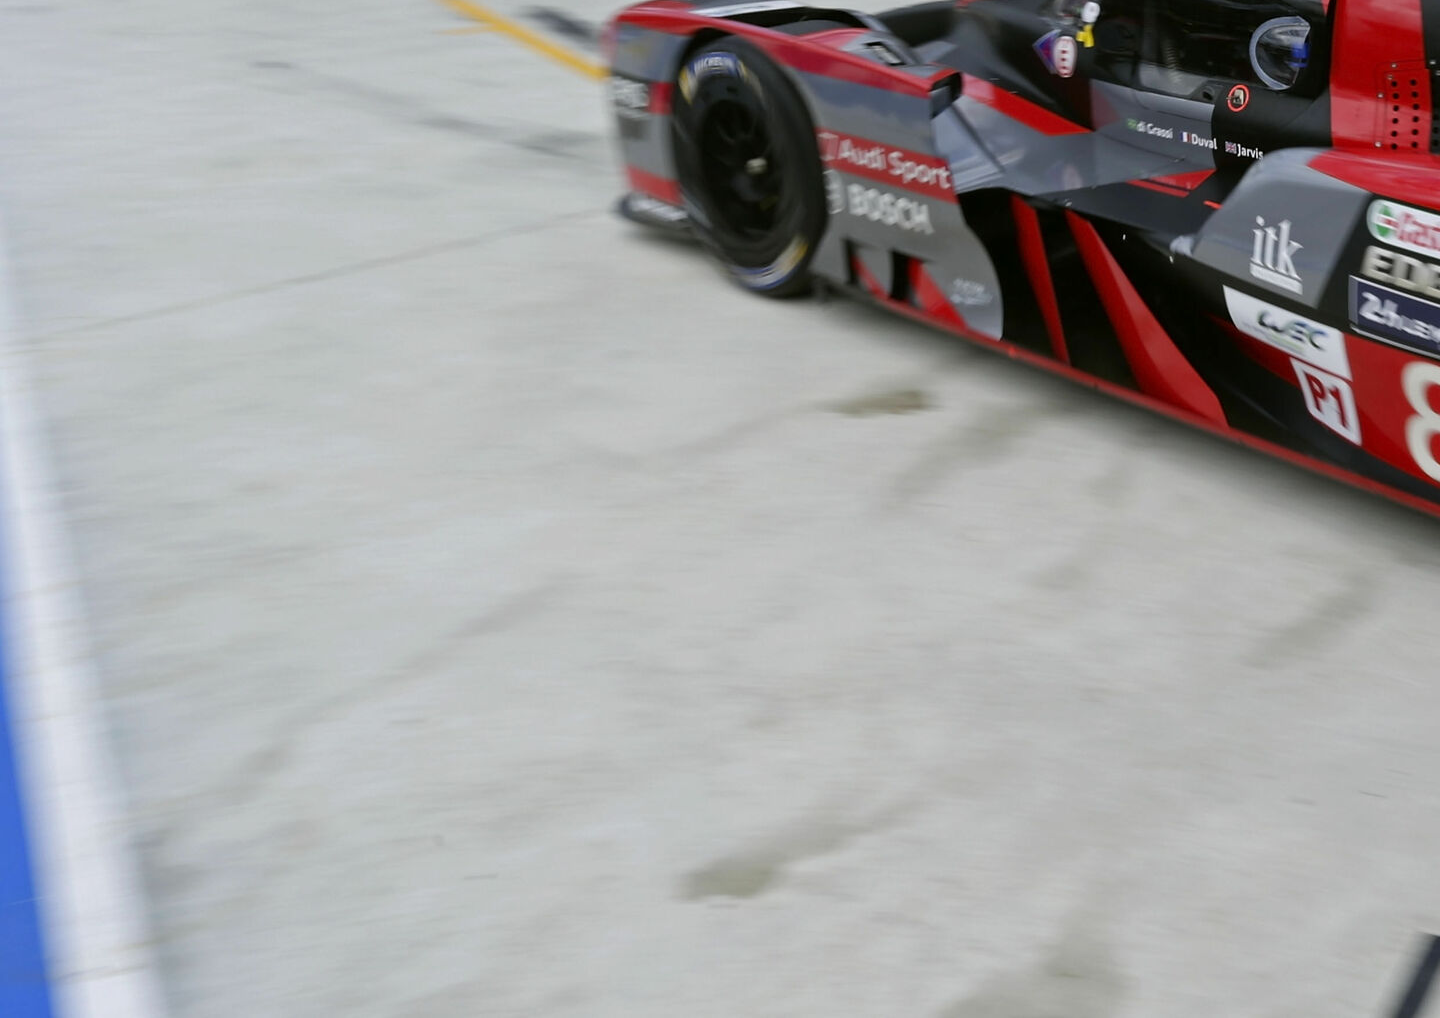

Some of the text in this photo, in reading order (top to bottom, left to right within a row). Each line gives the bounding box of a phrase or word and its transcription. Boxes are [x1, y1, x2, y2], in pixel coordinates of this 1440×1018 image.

[838, 138, 951, 189] Audi Sport
[1191, 133, 1218, 150] Duval
[1237, 143, 1264, 160] Jarvis
[848, 183, 935, 235] BOSCH
[1252, 215, 1304, 281] itk
[1302, 369, 1350, 430] P1
